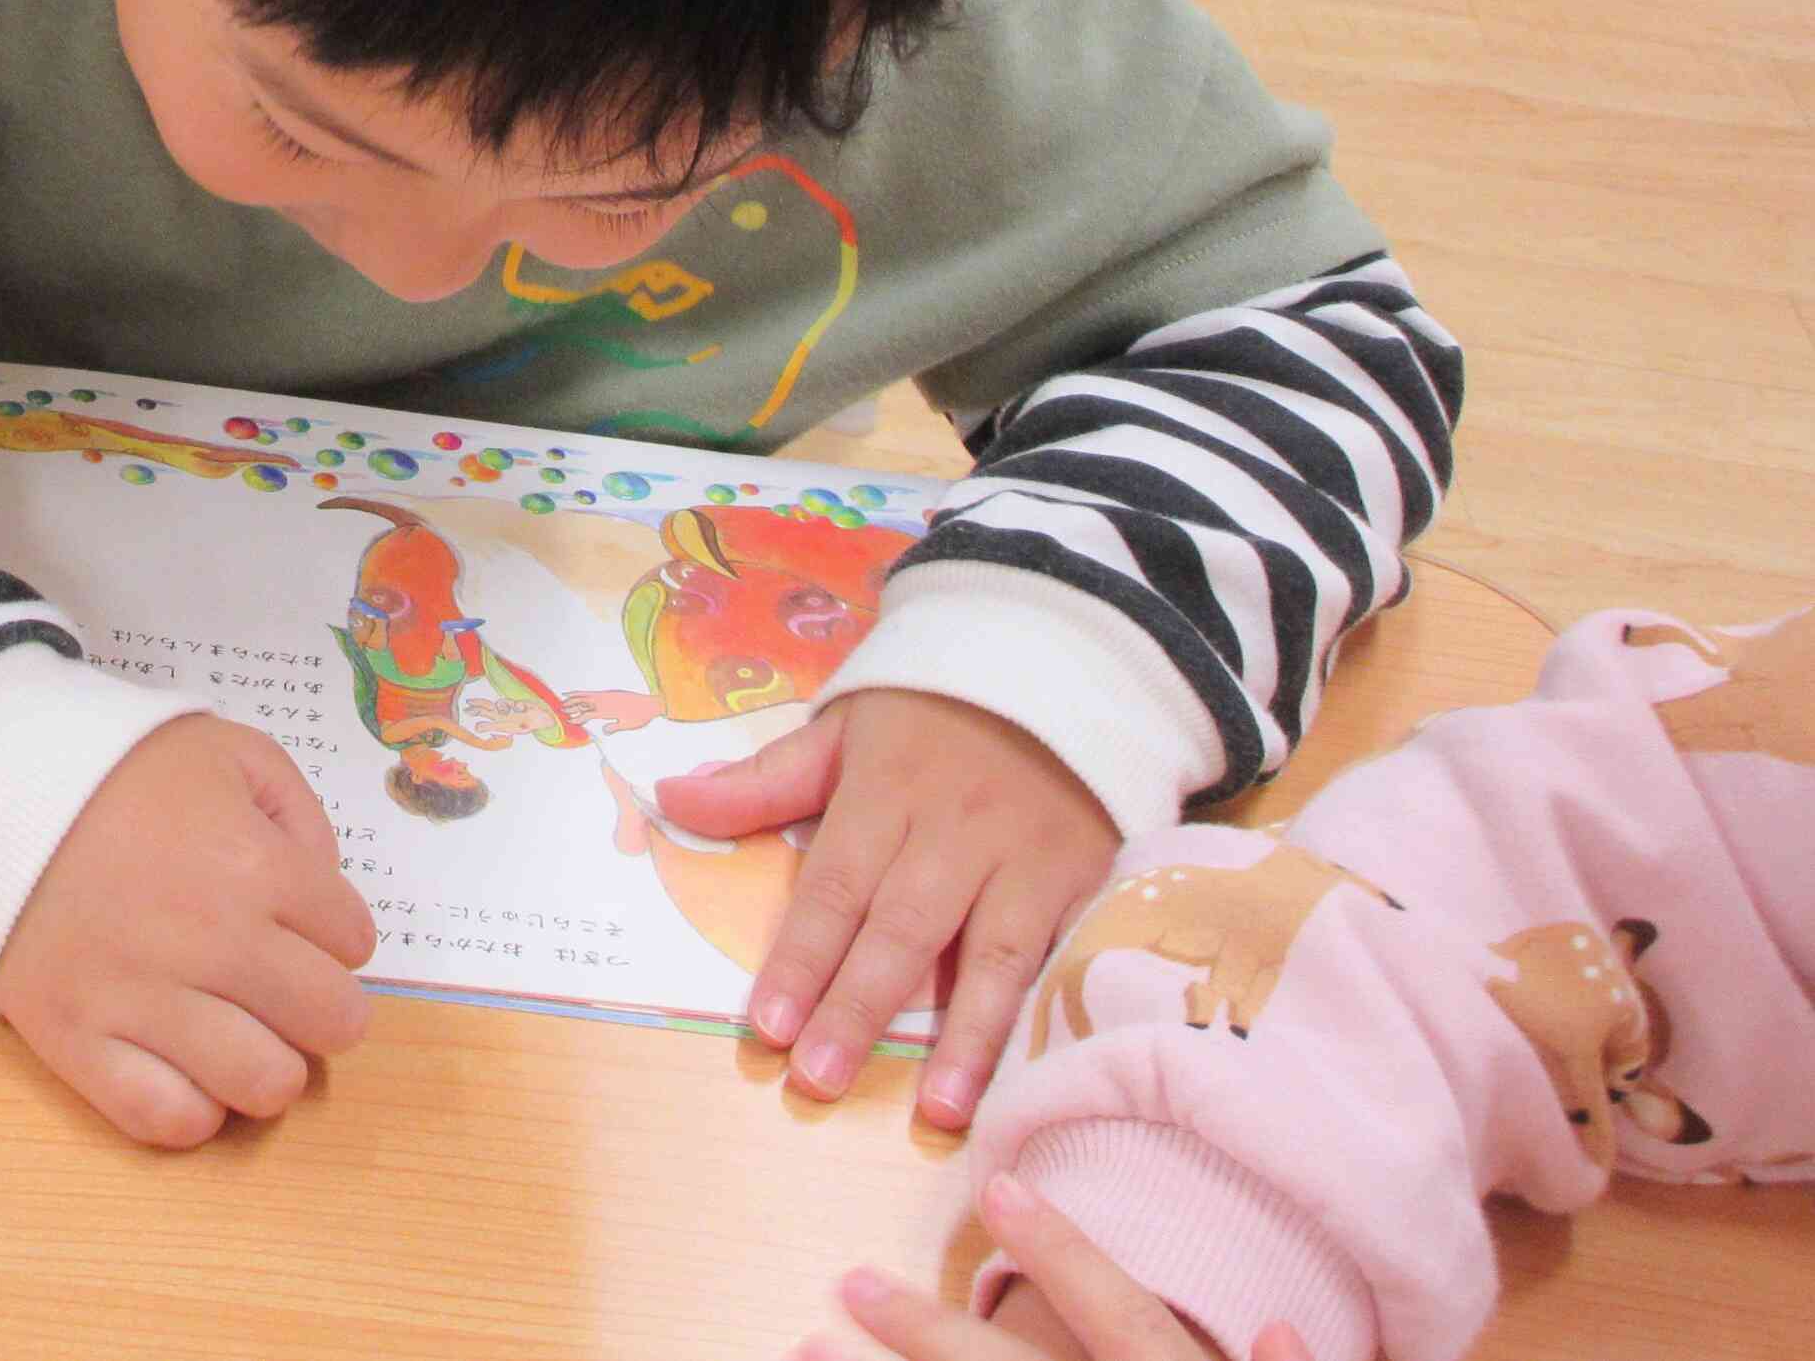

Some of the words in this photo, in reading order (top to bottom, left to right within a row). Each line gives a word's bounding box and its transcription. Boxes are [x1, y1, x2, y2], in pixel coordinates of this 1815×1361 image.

[112, 628, 324, 668] おたからまんちんは
[209, 670, 324, 695] ありがたき
[255, 702, 324, 723] そんな
[554, 947, 630, 966] つぎは
